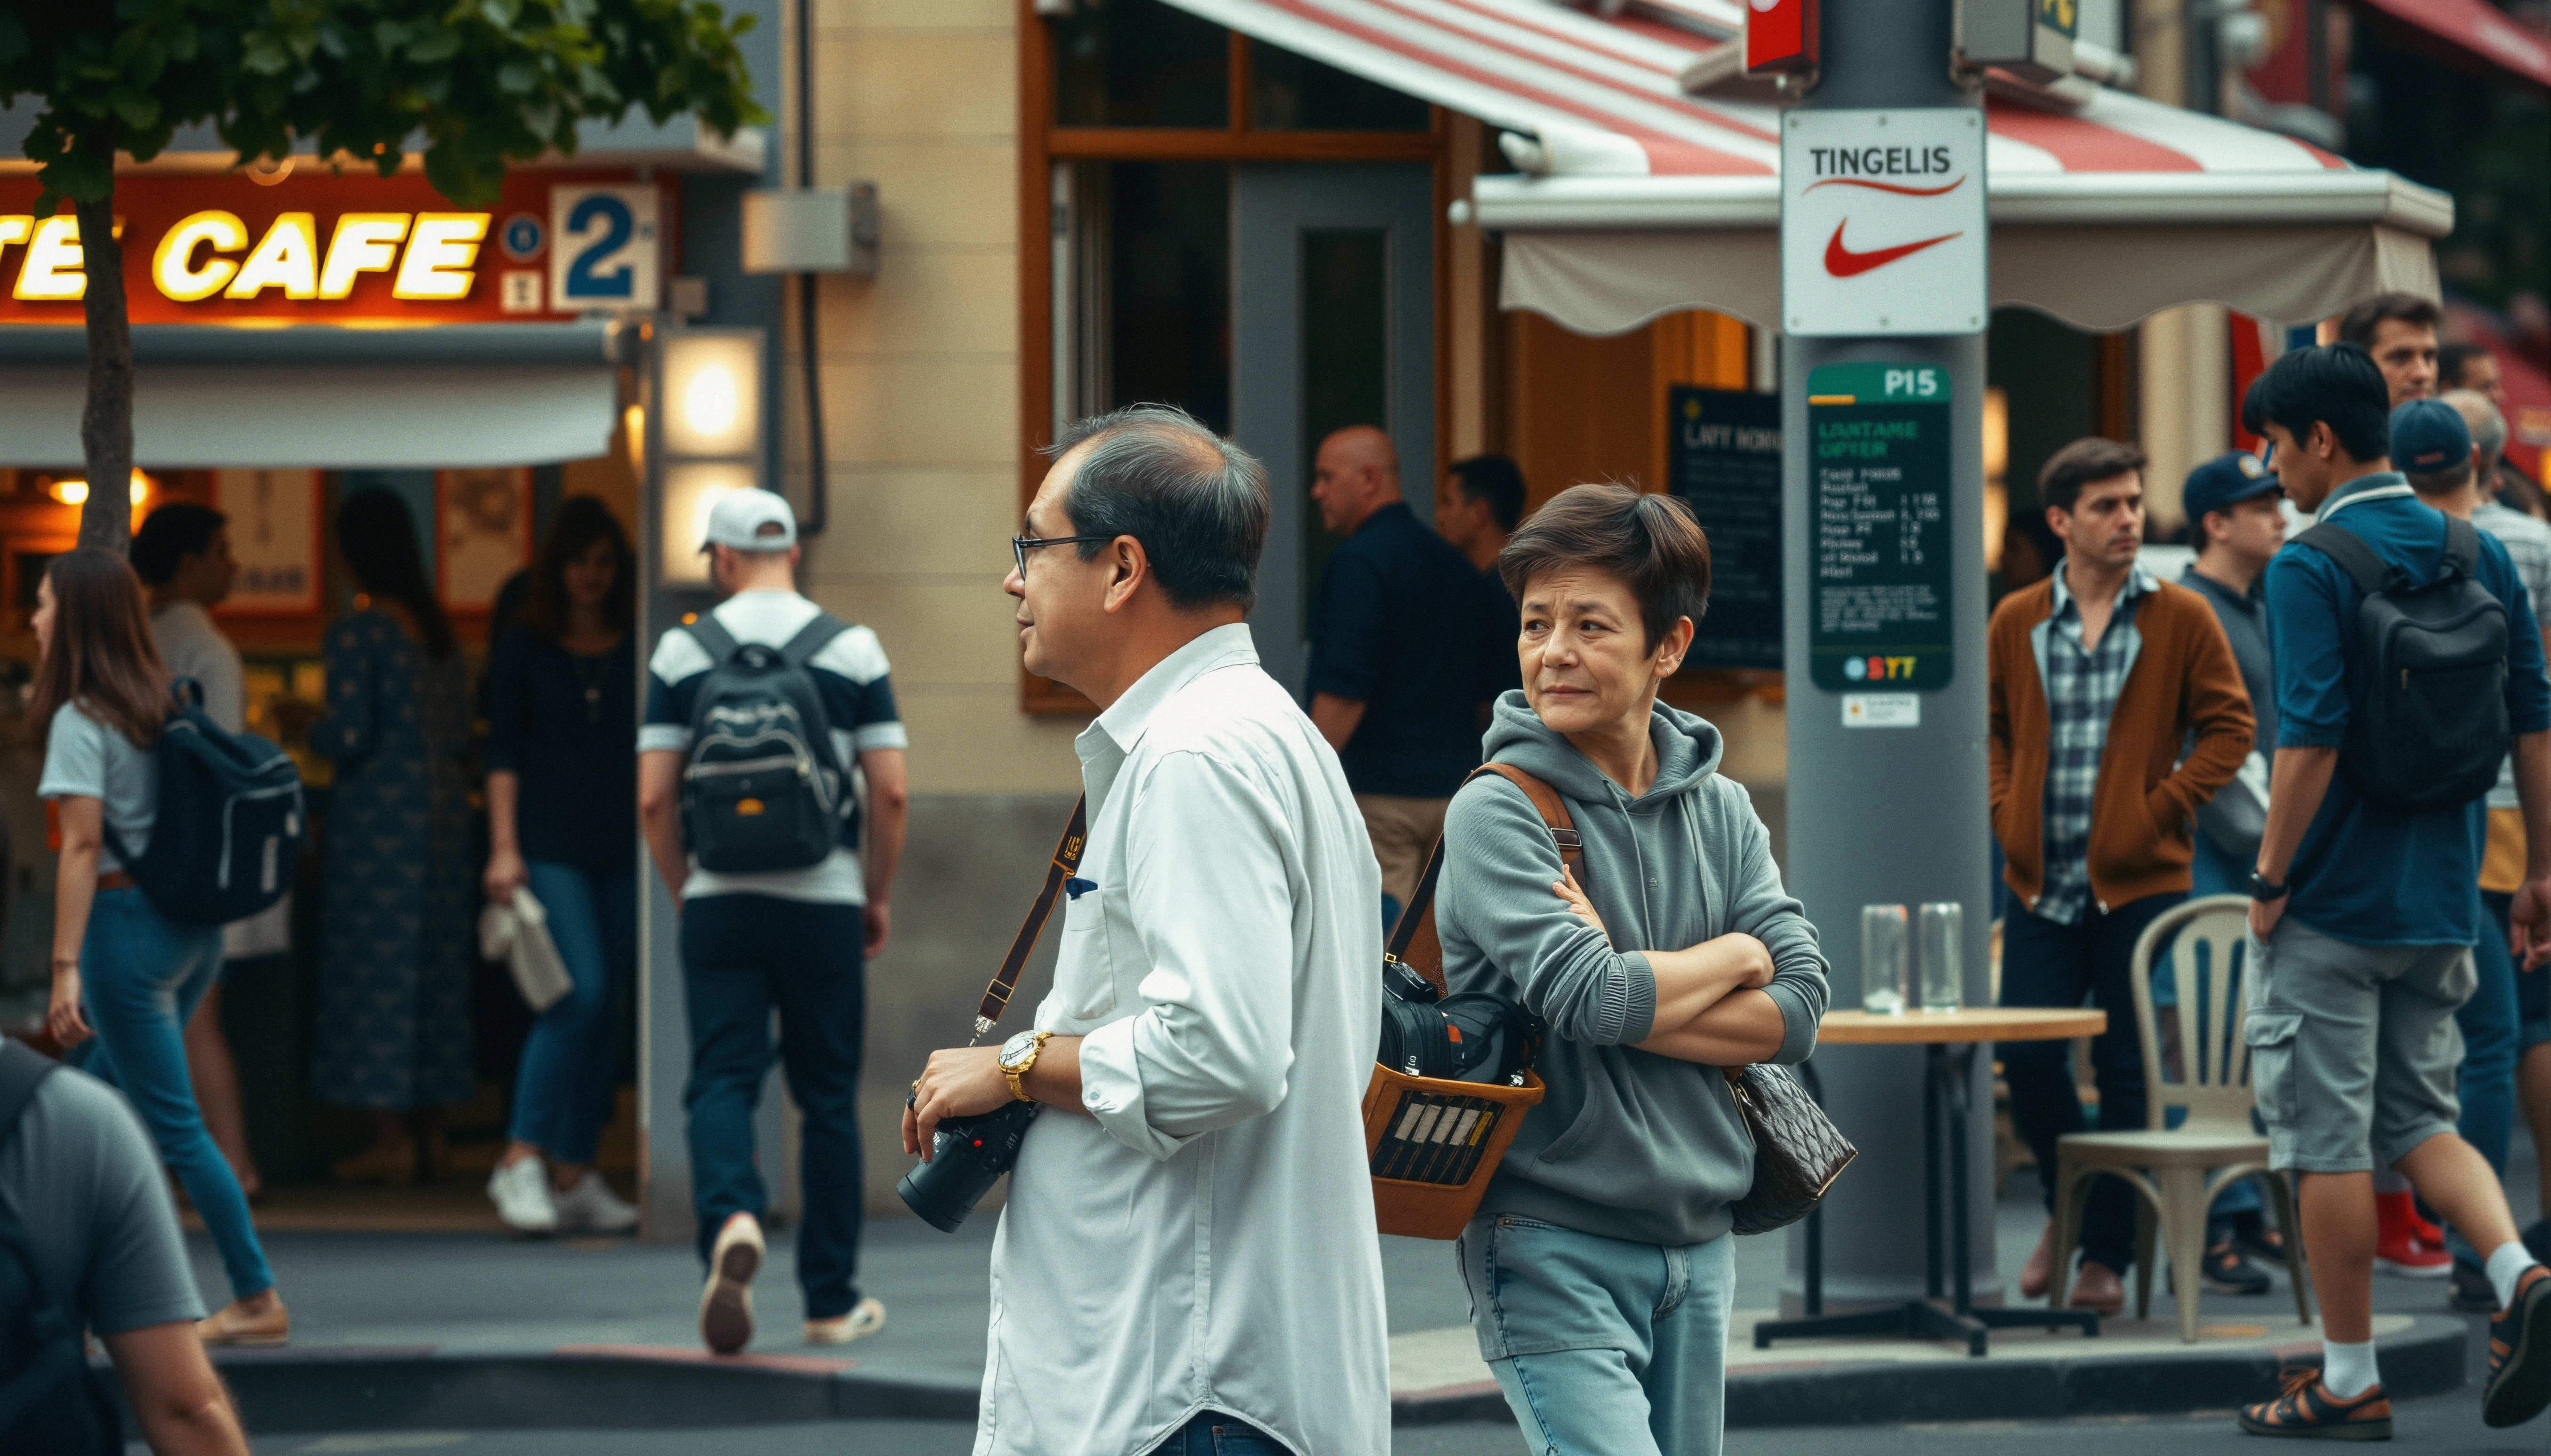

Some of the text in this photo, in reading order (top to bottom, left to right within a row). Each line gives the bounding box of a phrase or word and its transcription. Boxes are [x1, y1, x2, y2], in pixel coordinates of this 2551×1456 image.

[1810, 146, 1950, 175] TINGELIS
[152, 210, 492, 301] CAFE
[566, 196, 632, 298] 2
[1885, 369, 1937, 396] P15
